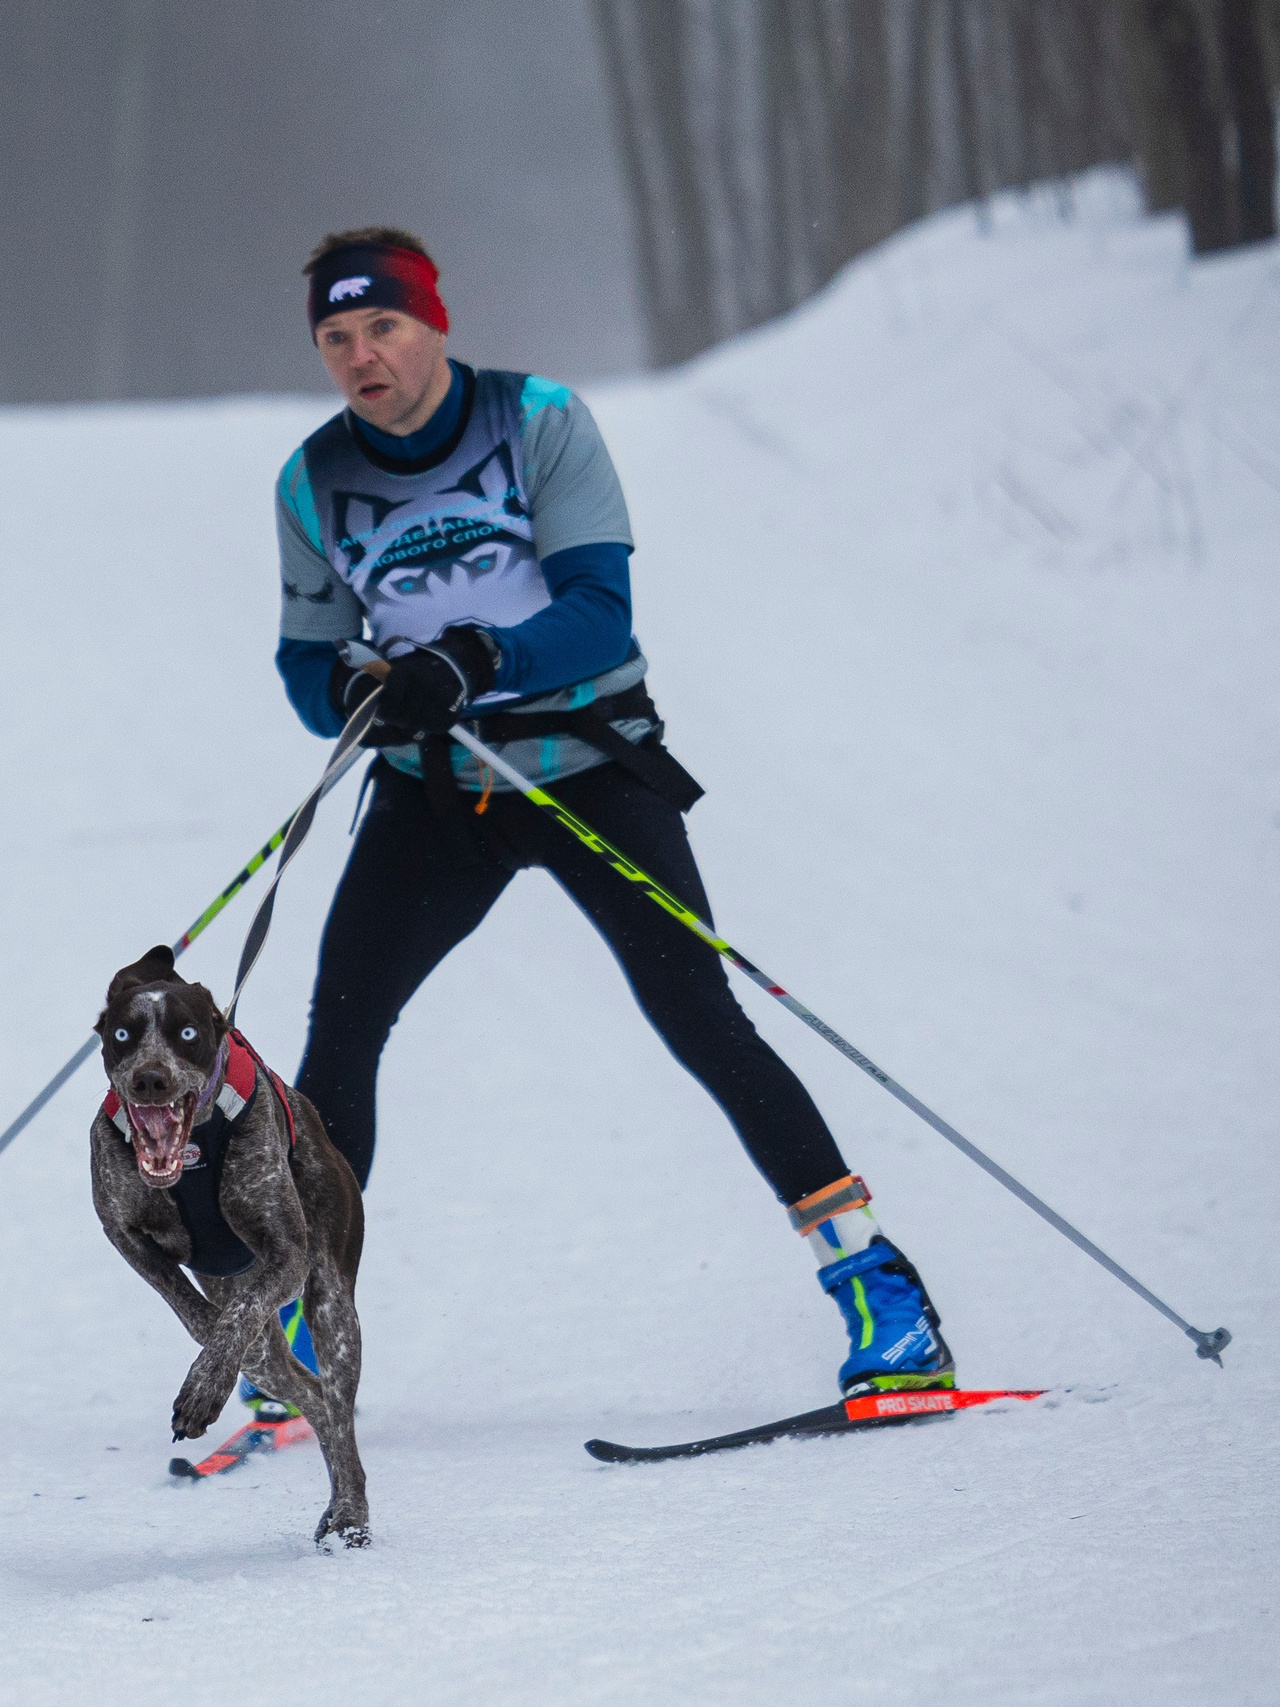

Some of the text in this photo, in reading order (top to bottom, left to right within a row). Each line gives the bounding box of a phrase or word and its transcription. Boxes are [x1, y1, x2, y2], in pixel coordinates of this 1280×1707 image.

[881, 1316, 929, 1365] SPINE
[876, 1394, 954, 1415] PRO SKATE
